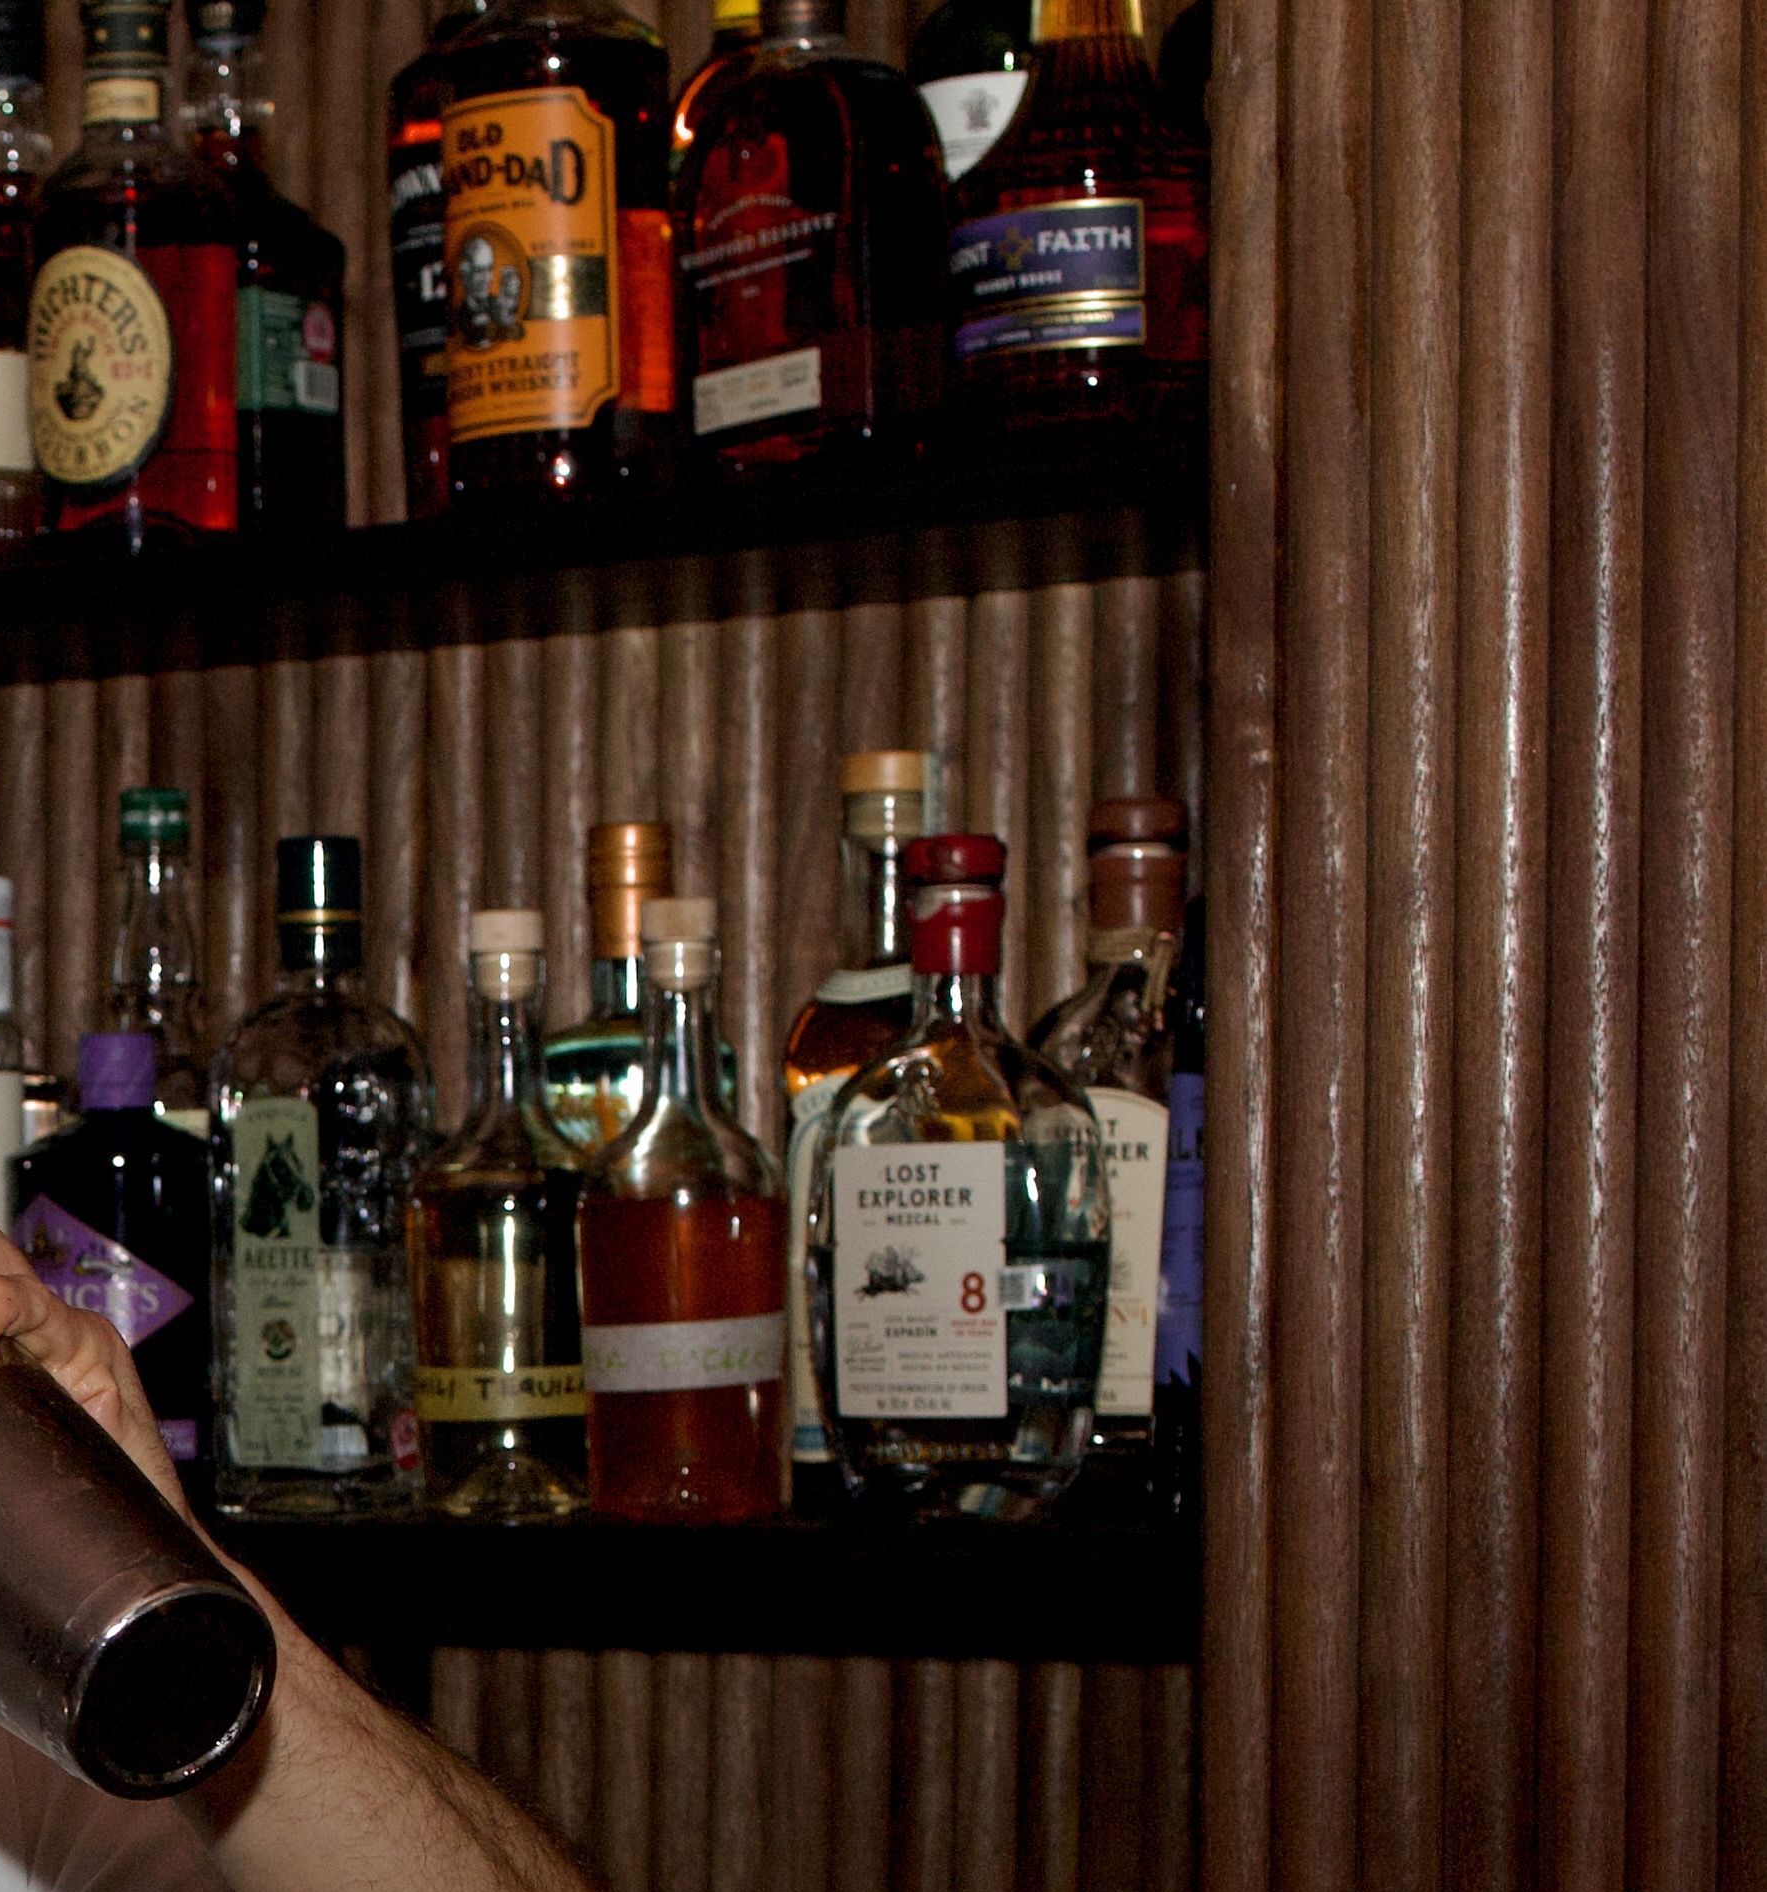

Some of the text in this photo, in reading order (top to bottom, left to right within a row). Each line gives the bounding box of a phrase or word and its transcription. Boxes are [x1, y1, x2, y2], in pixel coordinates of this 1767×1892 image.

[1037, 225, 1132, 256] FAITH
[885, 1164, 940, 1184] LOST
[859, 1188, 972, 1209] EXPLORER
[885, 1214, 940, 1226] MEZCAL
[960, 1271, 987, 1314] 8
